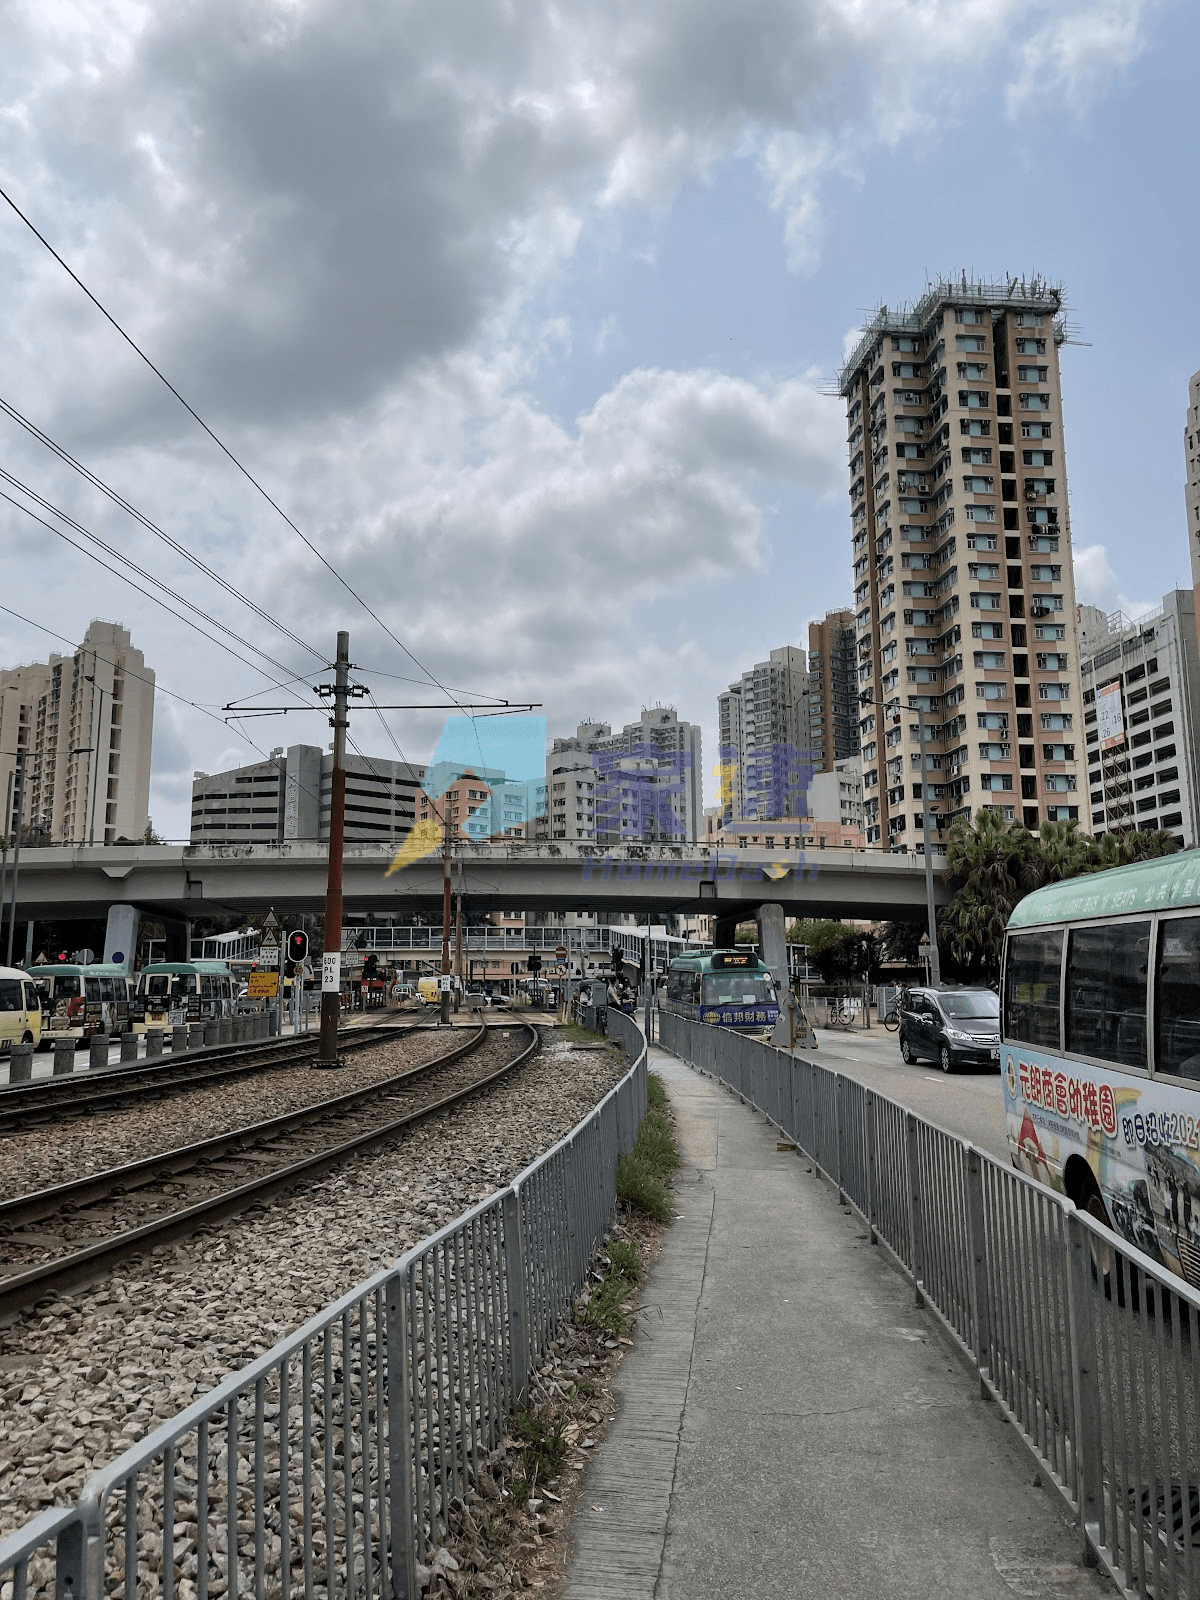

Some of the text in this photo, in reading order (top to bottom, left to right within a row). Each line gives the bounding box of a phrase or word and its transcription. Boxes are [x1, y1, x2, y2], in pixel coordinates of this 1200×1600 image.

[324, 975, 334, 983] 23
[721, 1011, 767, 1023] 信邦財務
[1018, 1060, 1118, 1136] 元朗商會幼稚園
[1121, 1111, 1200, 1146] 即日招收202
